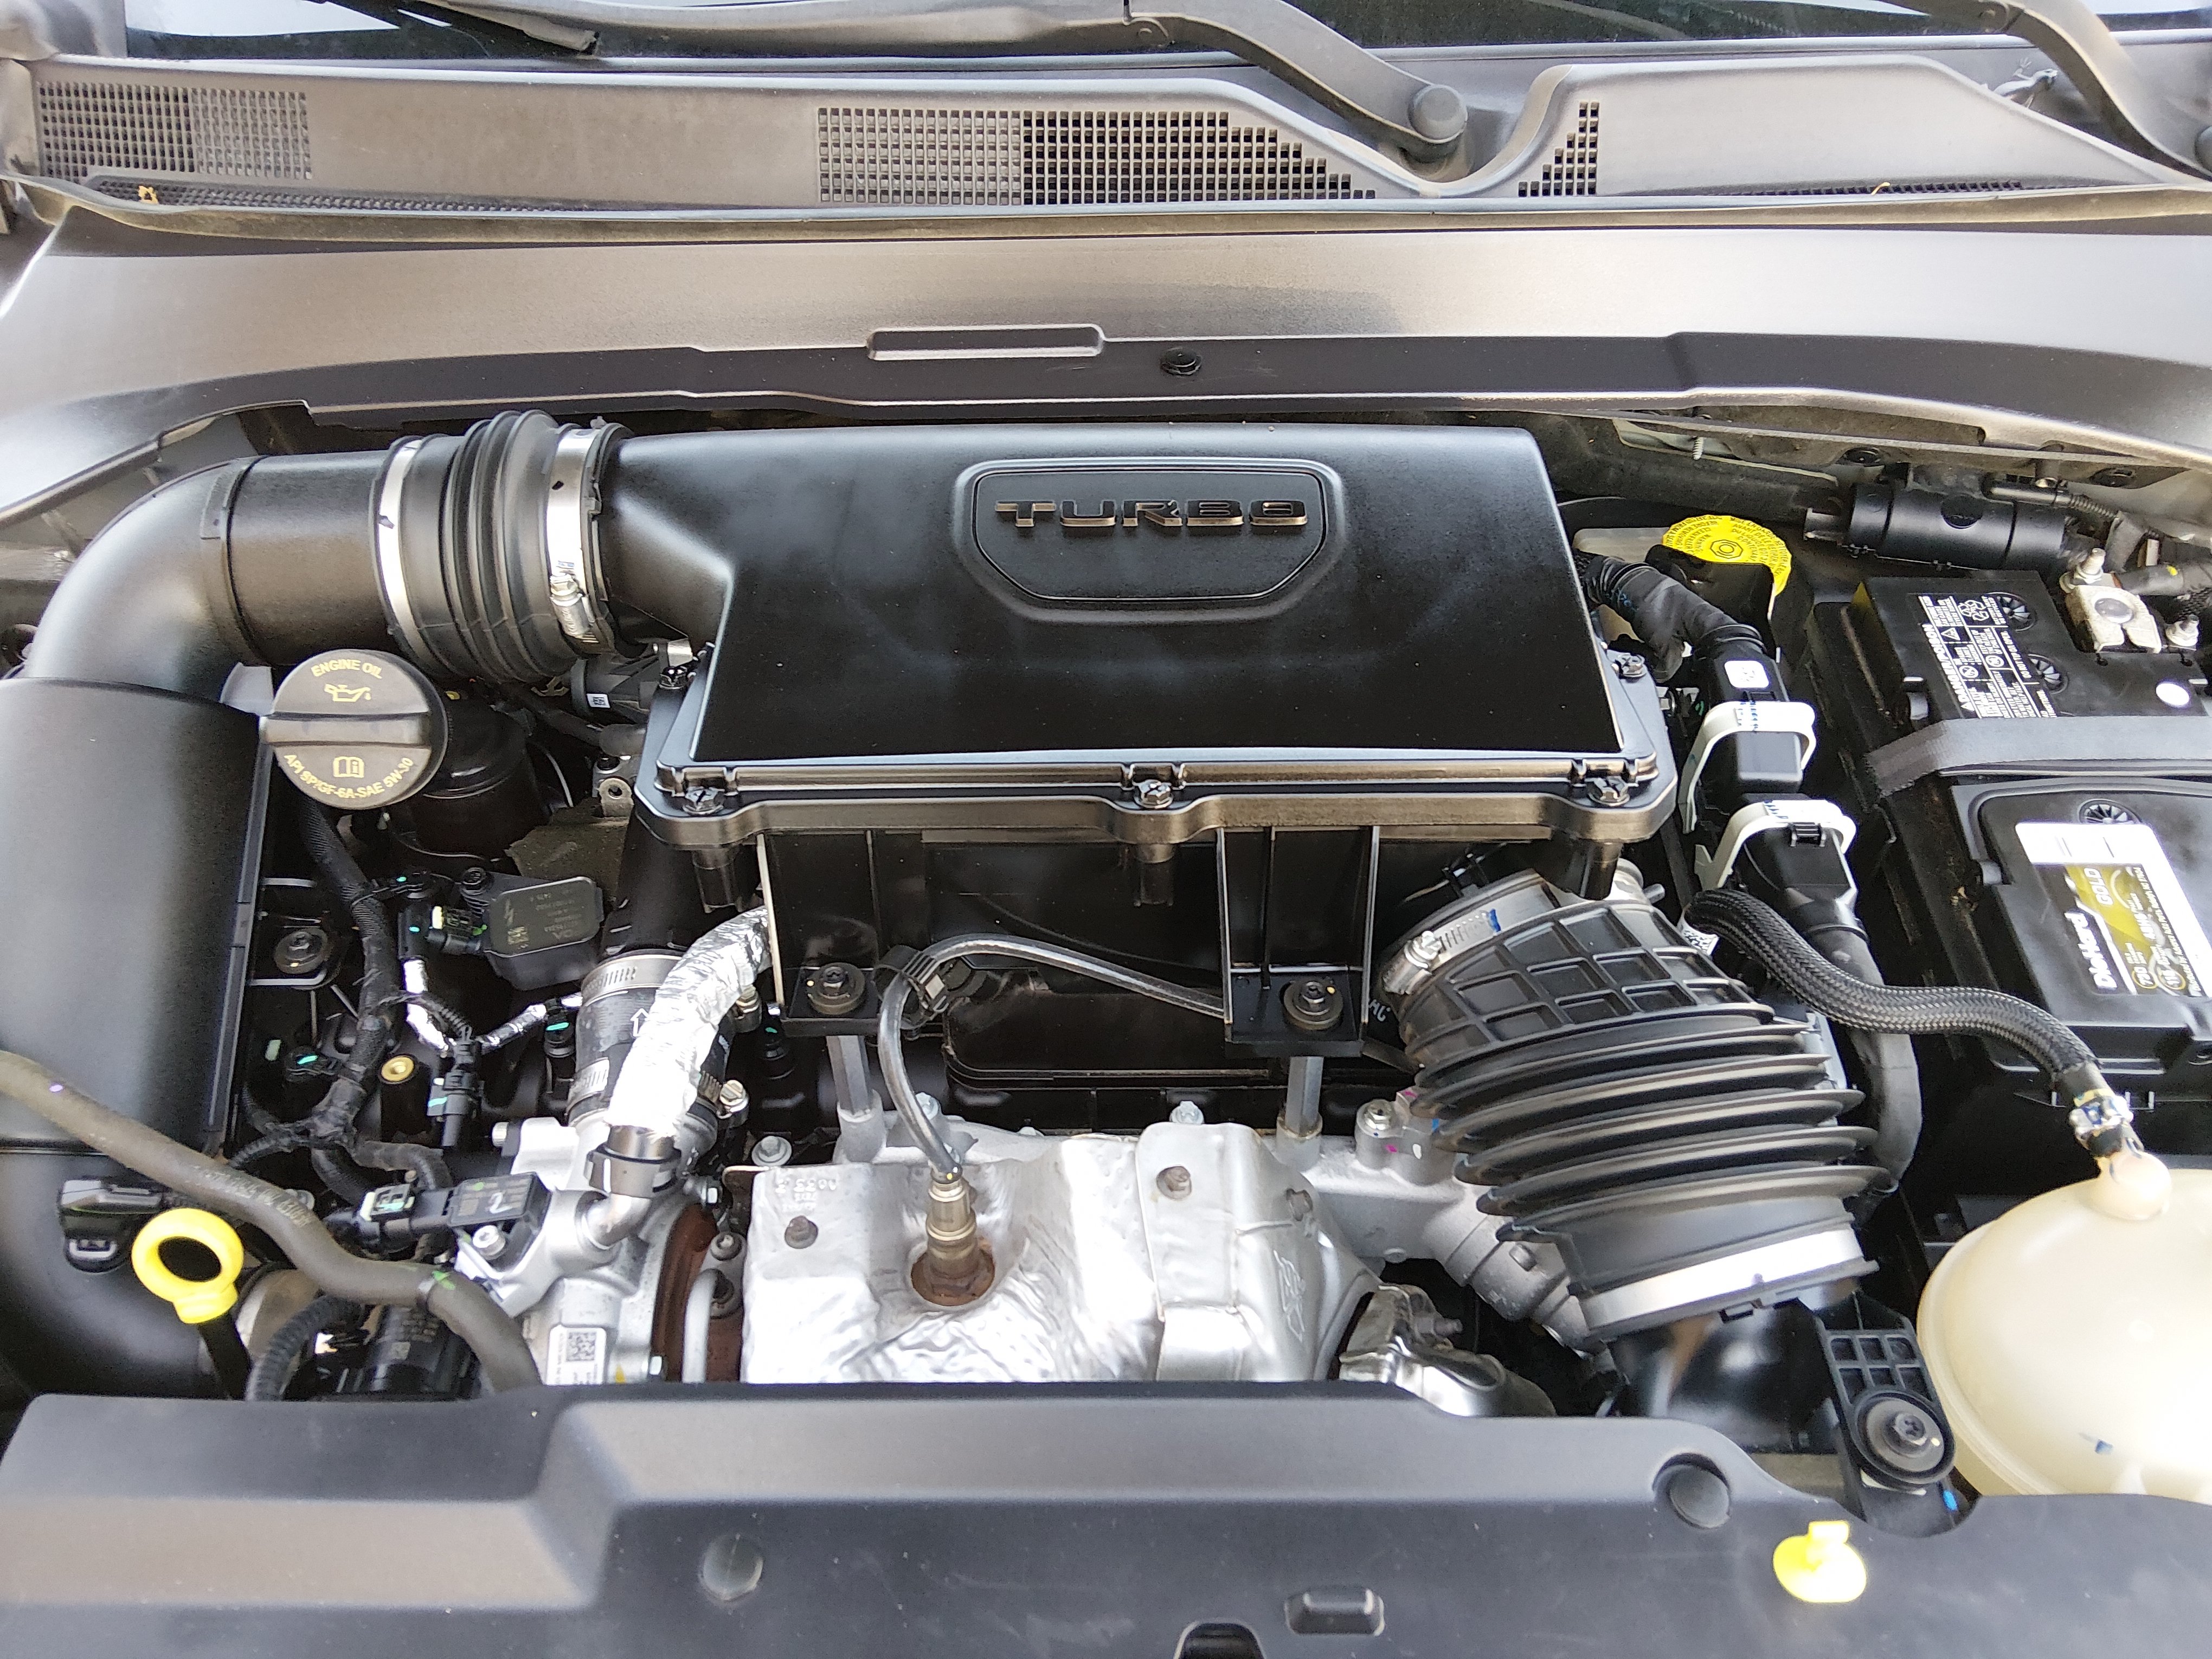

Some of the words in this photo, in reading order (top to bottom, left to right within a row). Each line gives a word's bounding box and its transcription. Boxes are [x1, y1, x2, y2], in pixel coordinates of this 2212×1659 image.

[995, 499, 1308, 527] TURBO
[311, 659, 361, 677] ENGINE
[362, 662, 383, 679] OIL
[284, 754, 300, 774] API
[383, 757, 414, 788] 5W-30
[2082, 867, 2114, 904] GOLD
[2063, 912, 2117, 987] DieHard
[2132, 966, 2153, 985] 730
